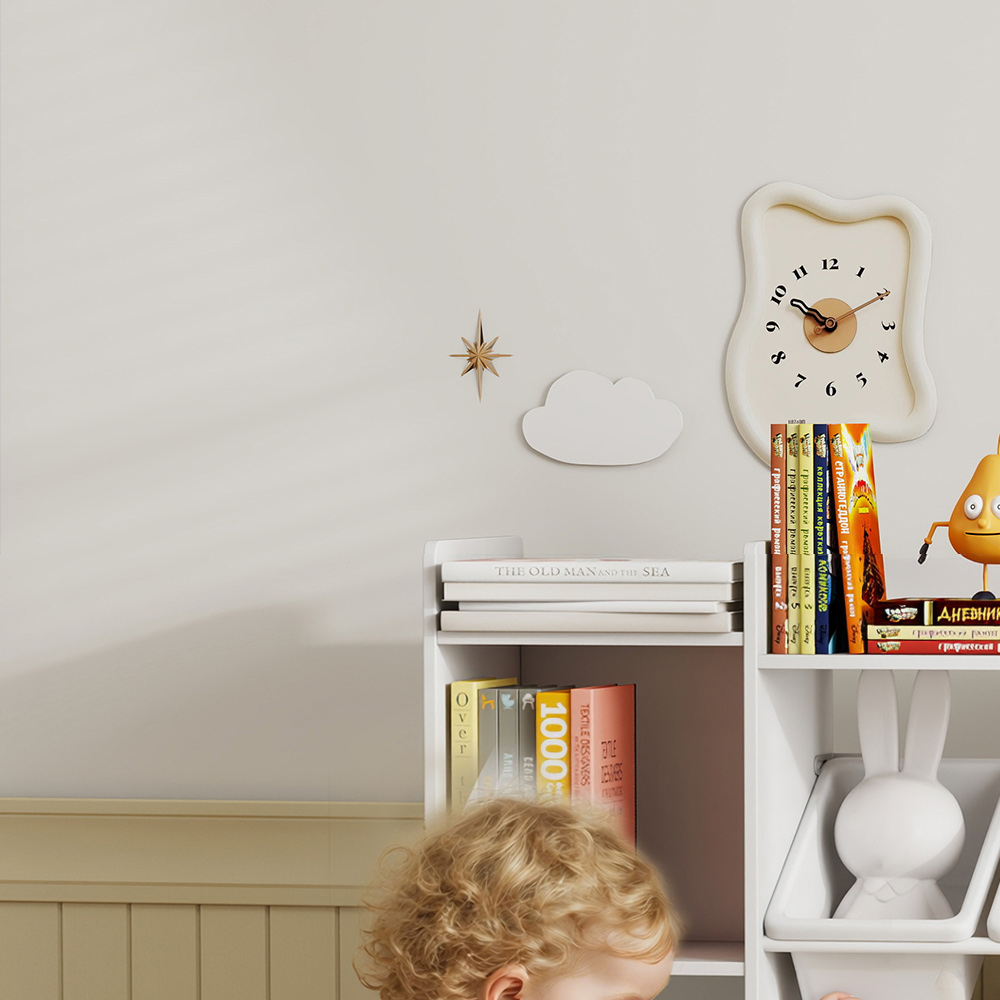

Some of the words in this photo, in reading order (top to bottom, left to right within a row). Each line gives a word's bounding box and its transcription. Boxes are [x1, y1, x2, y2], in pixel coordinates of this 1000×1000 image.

[821, 258, 840, 270] 12
[792, 265, 809, 281] 11
[856, 266, 866, 278] 1
[770, 284, 787, 306] 10
[765, 320, 781, 333] 9
[881, 320, 896, 331] 3
[770, 350, 787, 365] 8
[876, 350, 890, 364] 4
[794, 373, 807, 388] 7
[855, 372, 868, 388] 5
[825, 380, 837, 397] 6
[495, 566, 525, 576] THE
[529, 566, 561, 576] OLD
[564, 566, 597, 576] MAN
[642, 566, 671, 577] SEA
[540, 701, 568, 781] 1000
